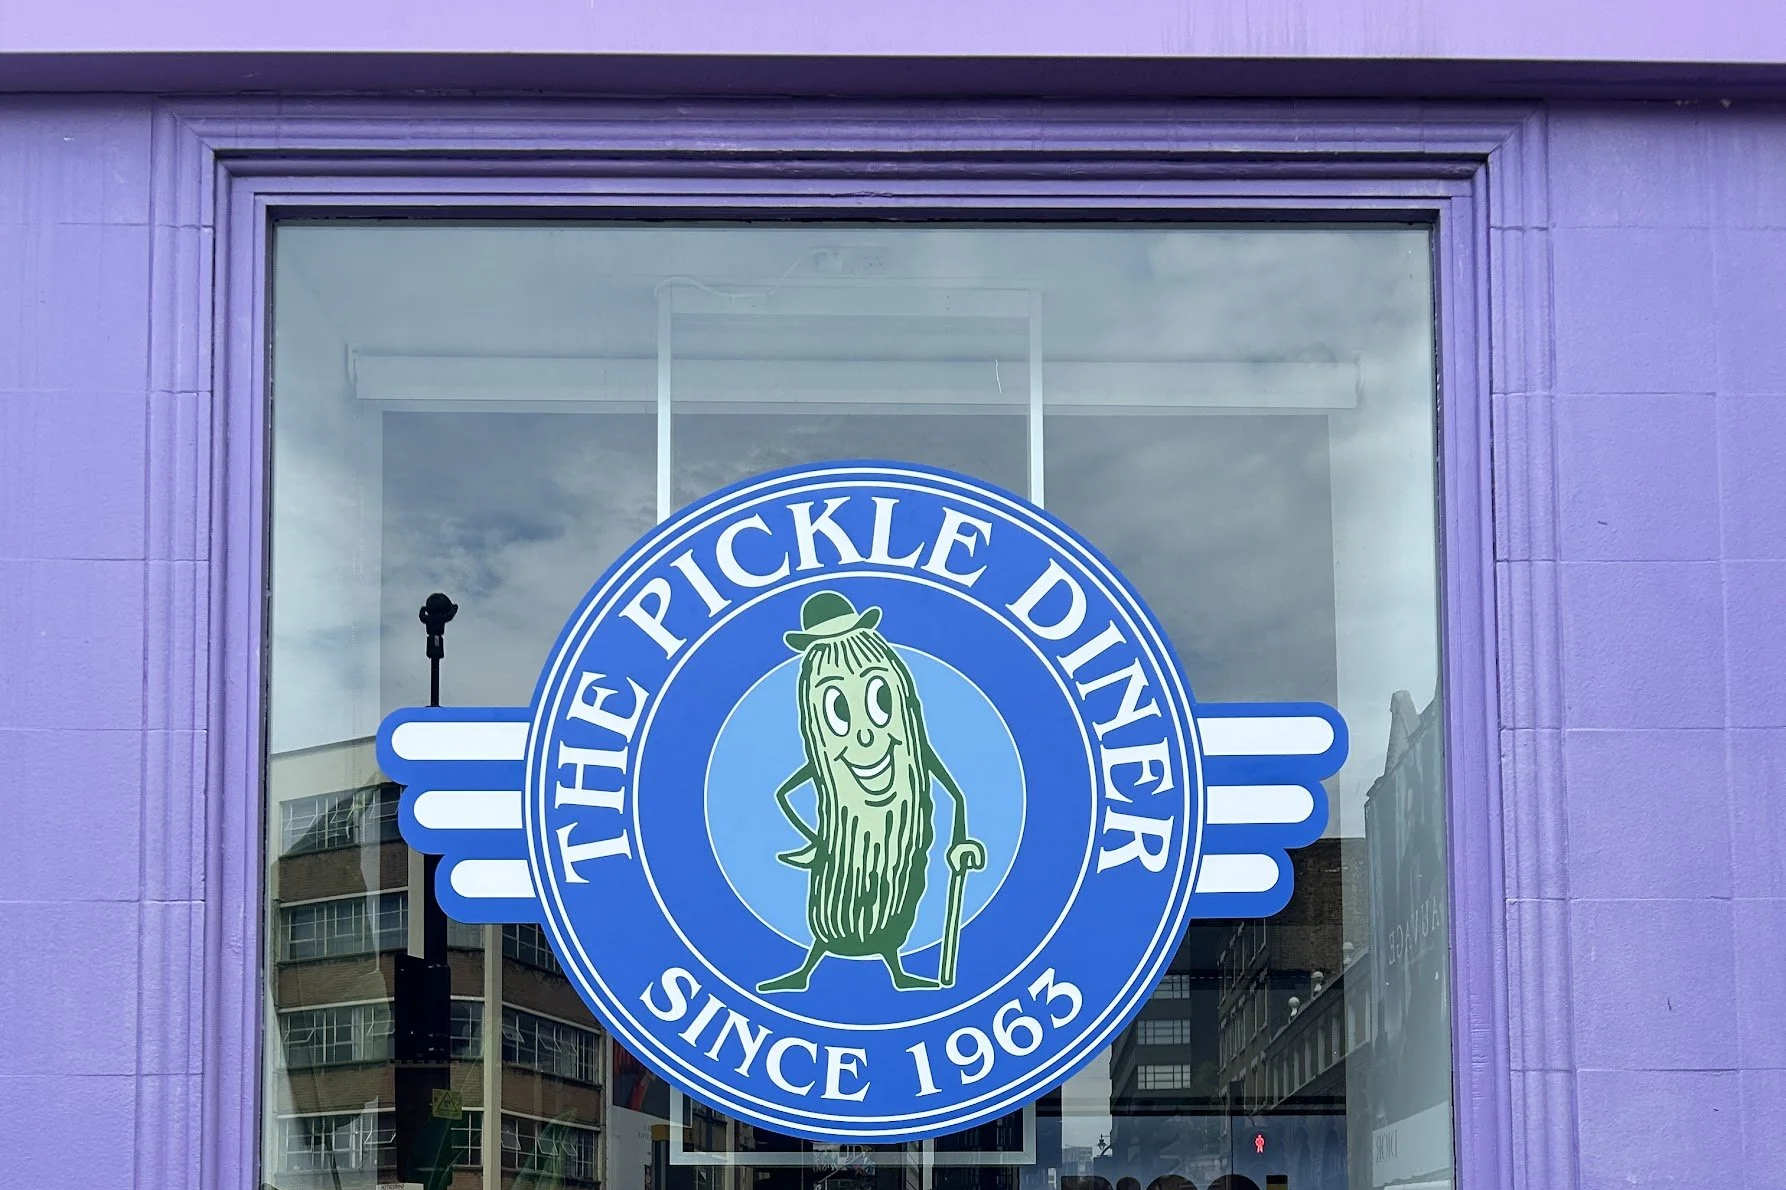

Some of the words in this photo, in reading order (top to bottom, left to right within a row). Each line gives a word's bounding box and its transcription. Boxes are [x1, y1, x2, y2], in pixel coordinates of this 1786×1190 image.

[555, 671, 650, 884] THE
[618, 496, 993, 660] PICKLE
[1005, 557, 1174, 875] DINER
[639, 967, 871, 1102] SINCE
[905, 967, 1083, 1097] 1963
